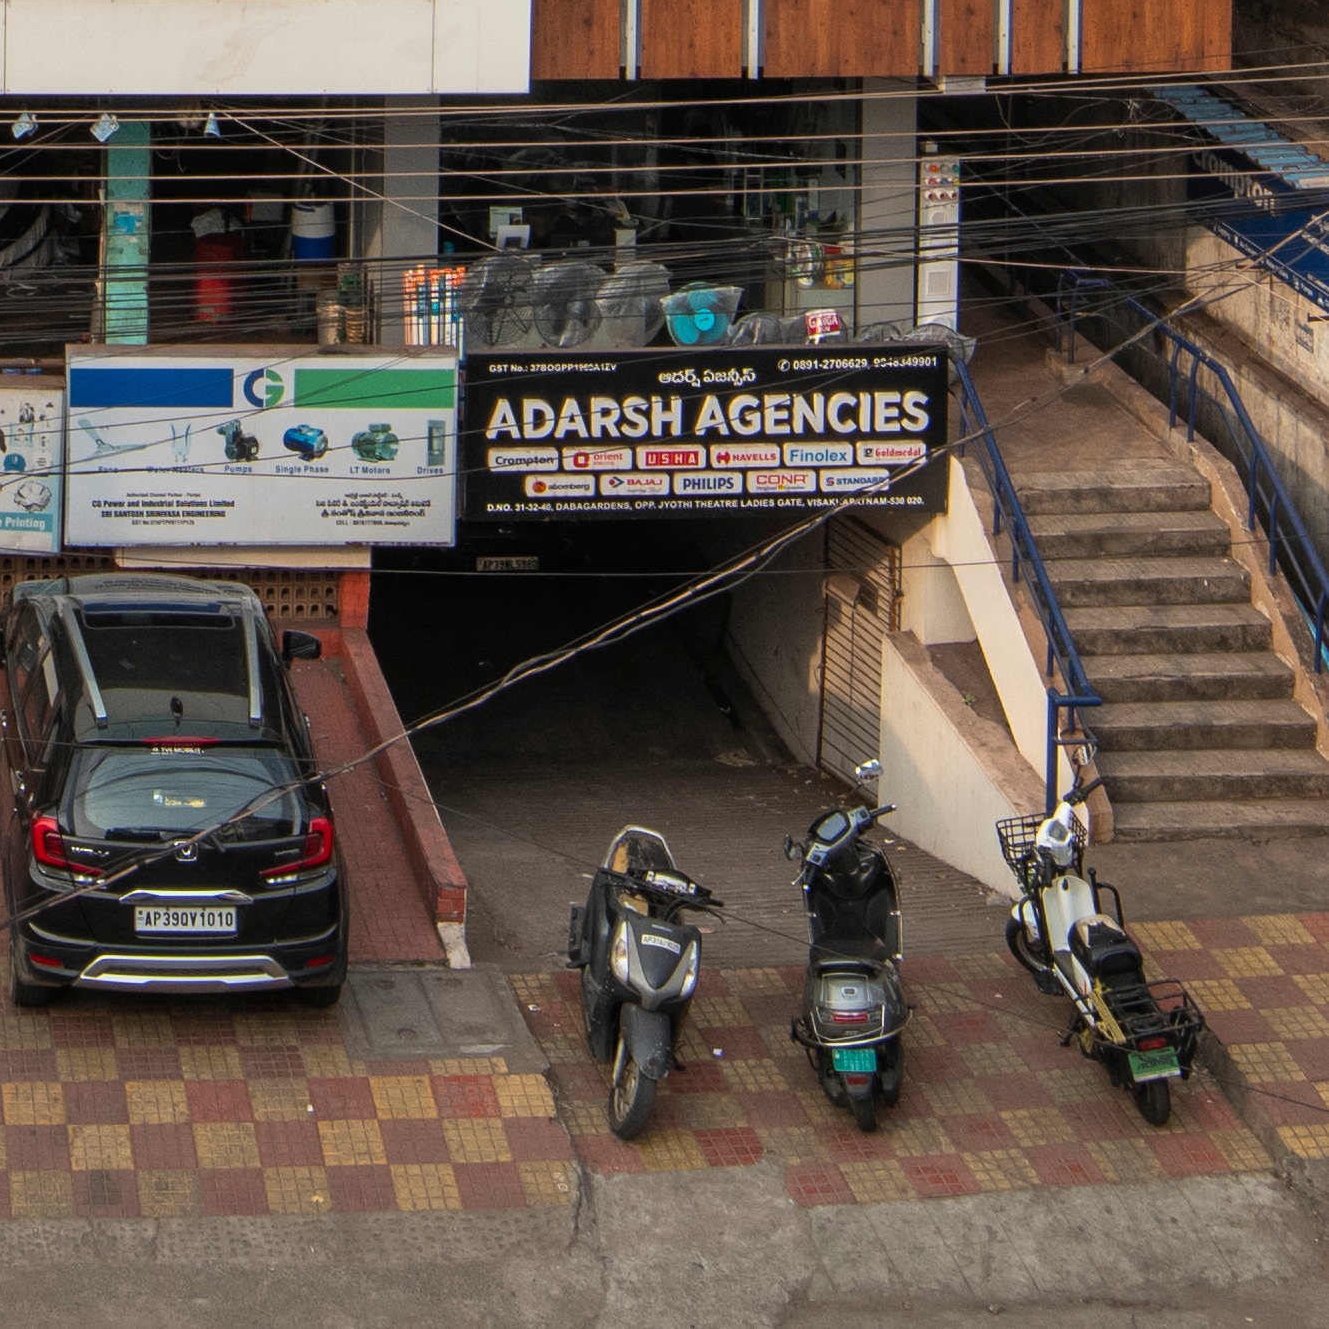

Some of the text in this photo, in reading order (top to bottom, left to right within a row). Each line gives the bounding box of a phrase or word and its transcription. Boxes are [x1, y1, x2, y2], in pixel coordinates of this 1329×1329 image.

[489, 364, 508, 373] GST
[486, 390, 931, 440] ADARSH AGENCIES
[495, 455, 554, 467] Crompton
[593, 452, 623, 461] orient
[647, 452, 697, 464] USHA
[732, 452, 777, 462] HAVELLS
[789, 449, 848, 463] Finolex
[224, 465, 252, 475] Pumps
[275, 464, 329, 475] Single Phase
[350, 465, 391, 474] LT Motors
[417, 465, 444, 474] Drives
[627, 478, 663, 486] BAJAJ
[683, 478, 734, 490] PHILIPS
[103, 500, 125, 508] Power
[127, 500, 140, 508] and
[556, 501, 633, 512] DABAGARDENS,
[658, 500, 692, 510] JYOTHI
[694, 500, 738, 509] THEATRE
[740, 498, 774, 508] LADIES
[5, 517, 46, 530] Printing
[144, 911, 234, 926] AP39QV1010
